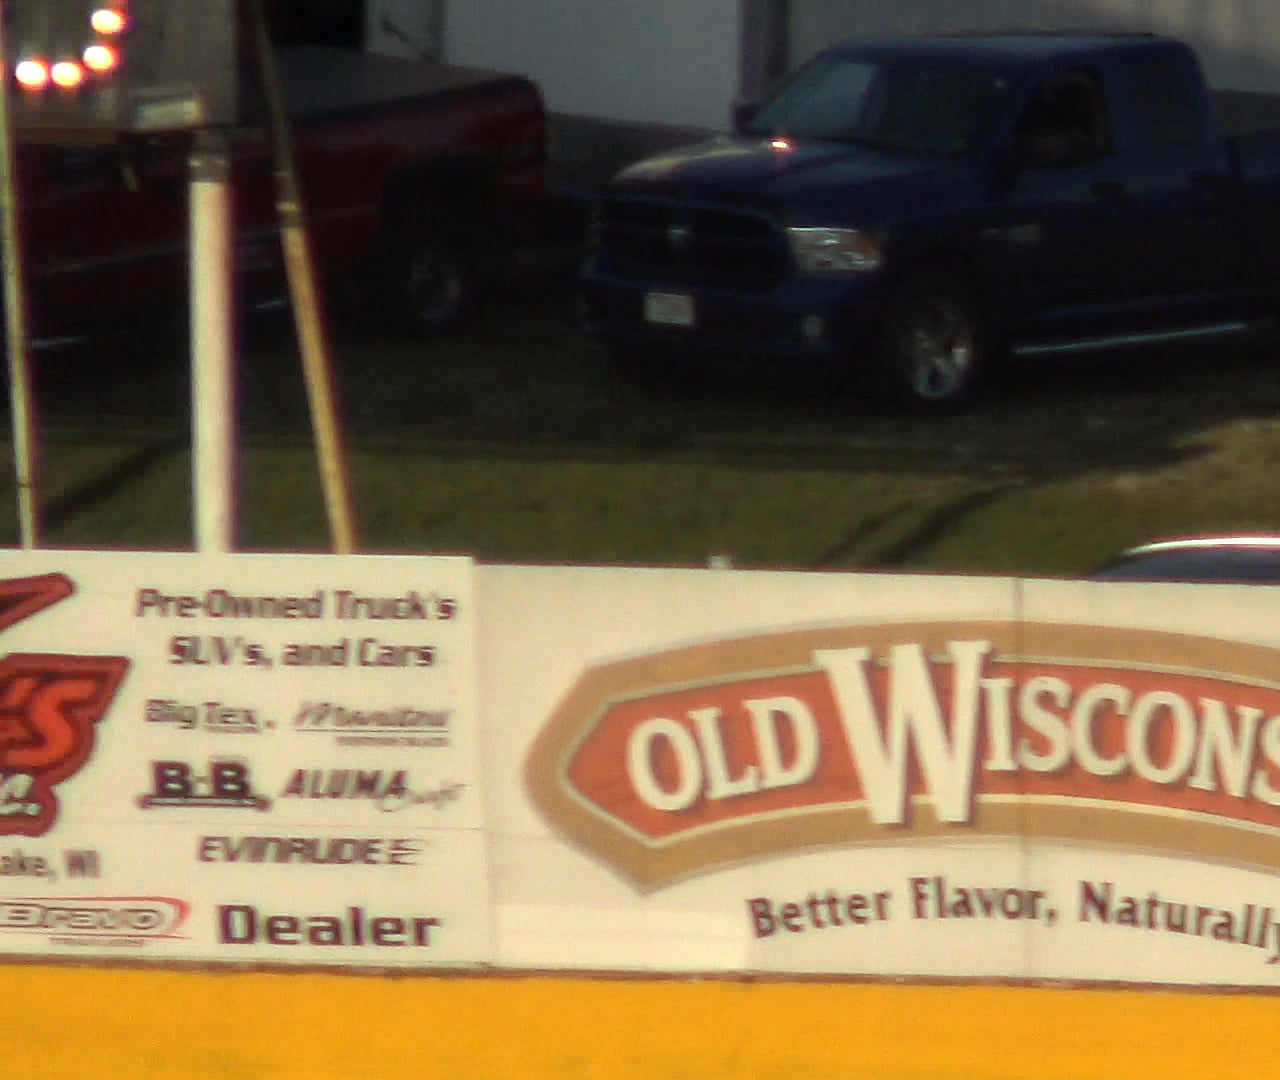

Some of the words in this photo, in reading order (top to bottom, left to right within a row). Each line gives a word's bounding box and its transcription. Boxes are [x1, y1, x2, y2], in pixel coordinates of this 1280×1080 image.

[136, 588, 325, 619] Pre-Owned
[334, 590, 457, 620] Truck's
[281, 638, 349, 666] and
[359, 638, 436, 667] Cars
[626, 695, 821, 813] OLD
[217, 903, 442, 947] Dealer
[746, 883, 894, 939] Better
[908, 875, 1060, 926] Flavor,
